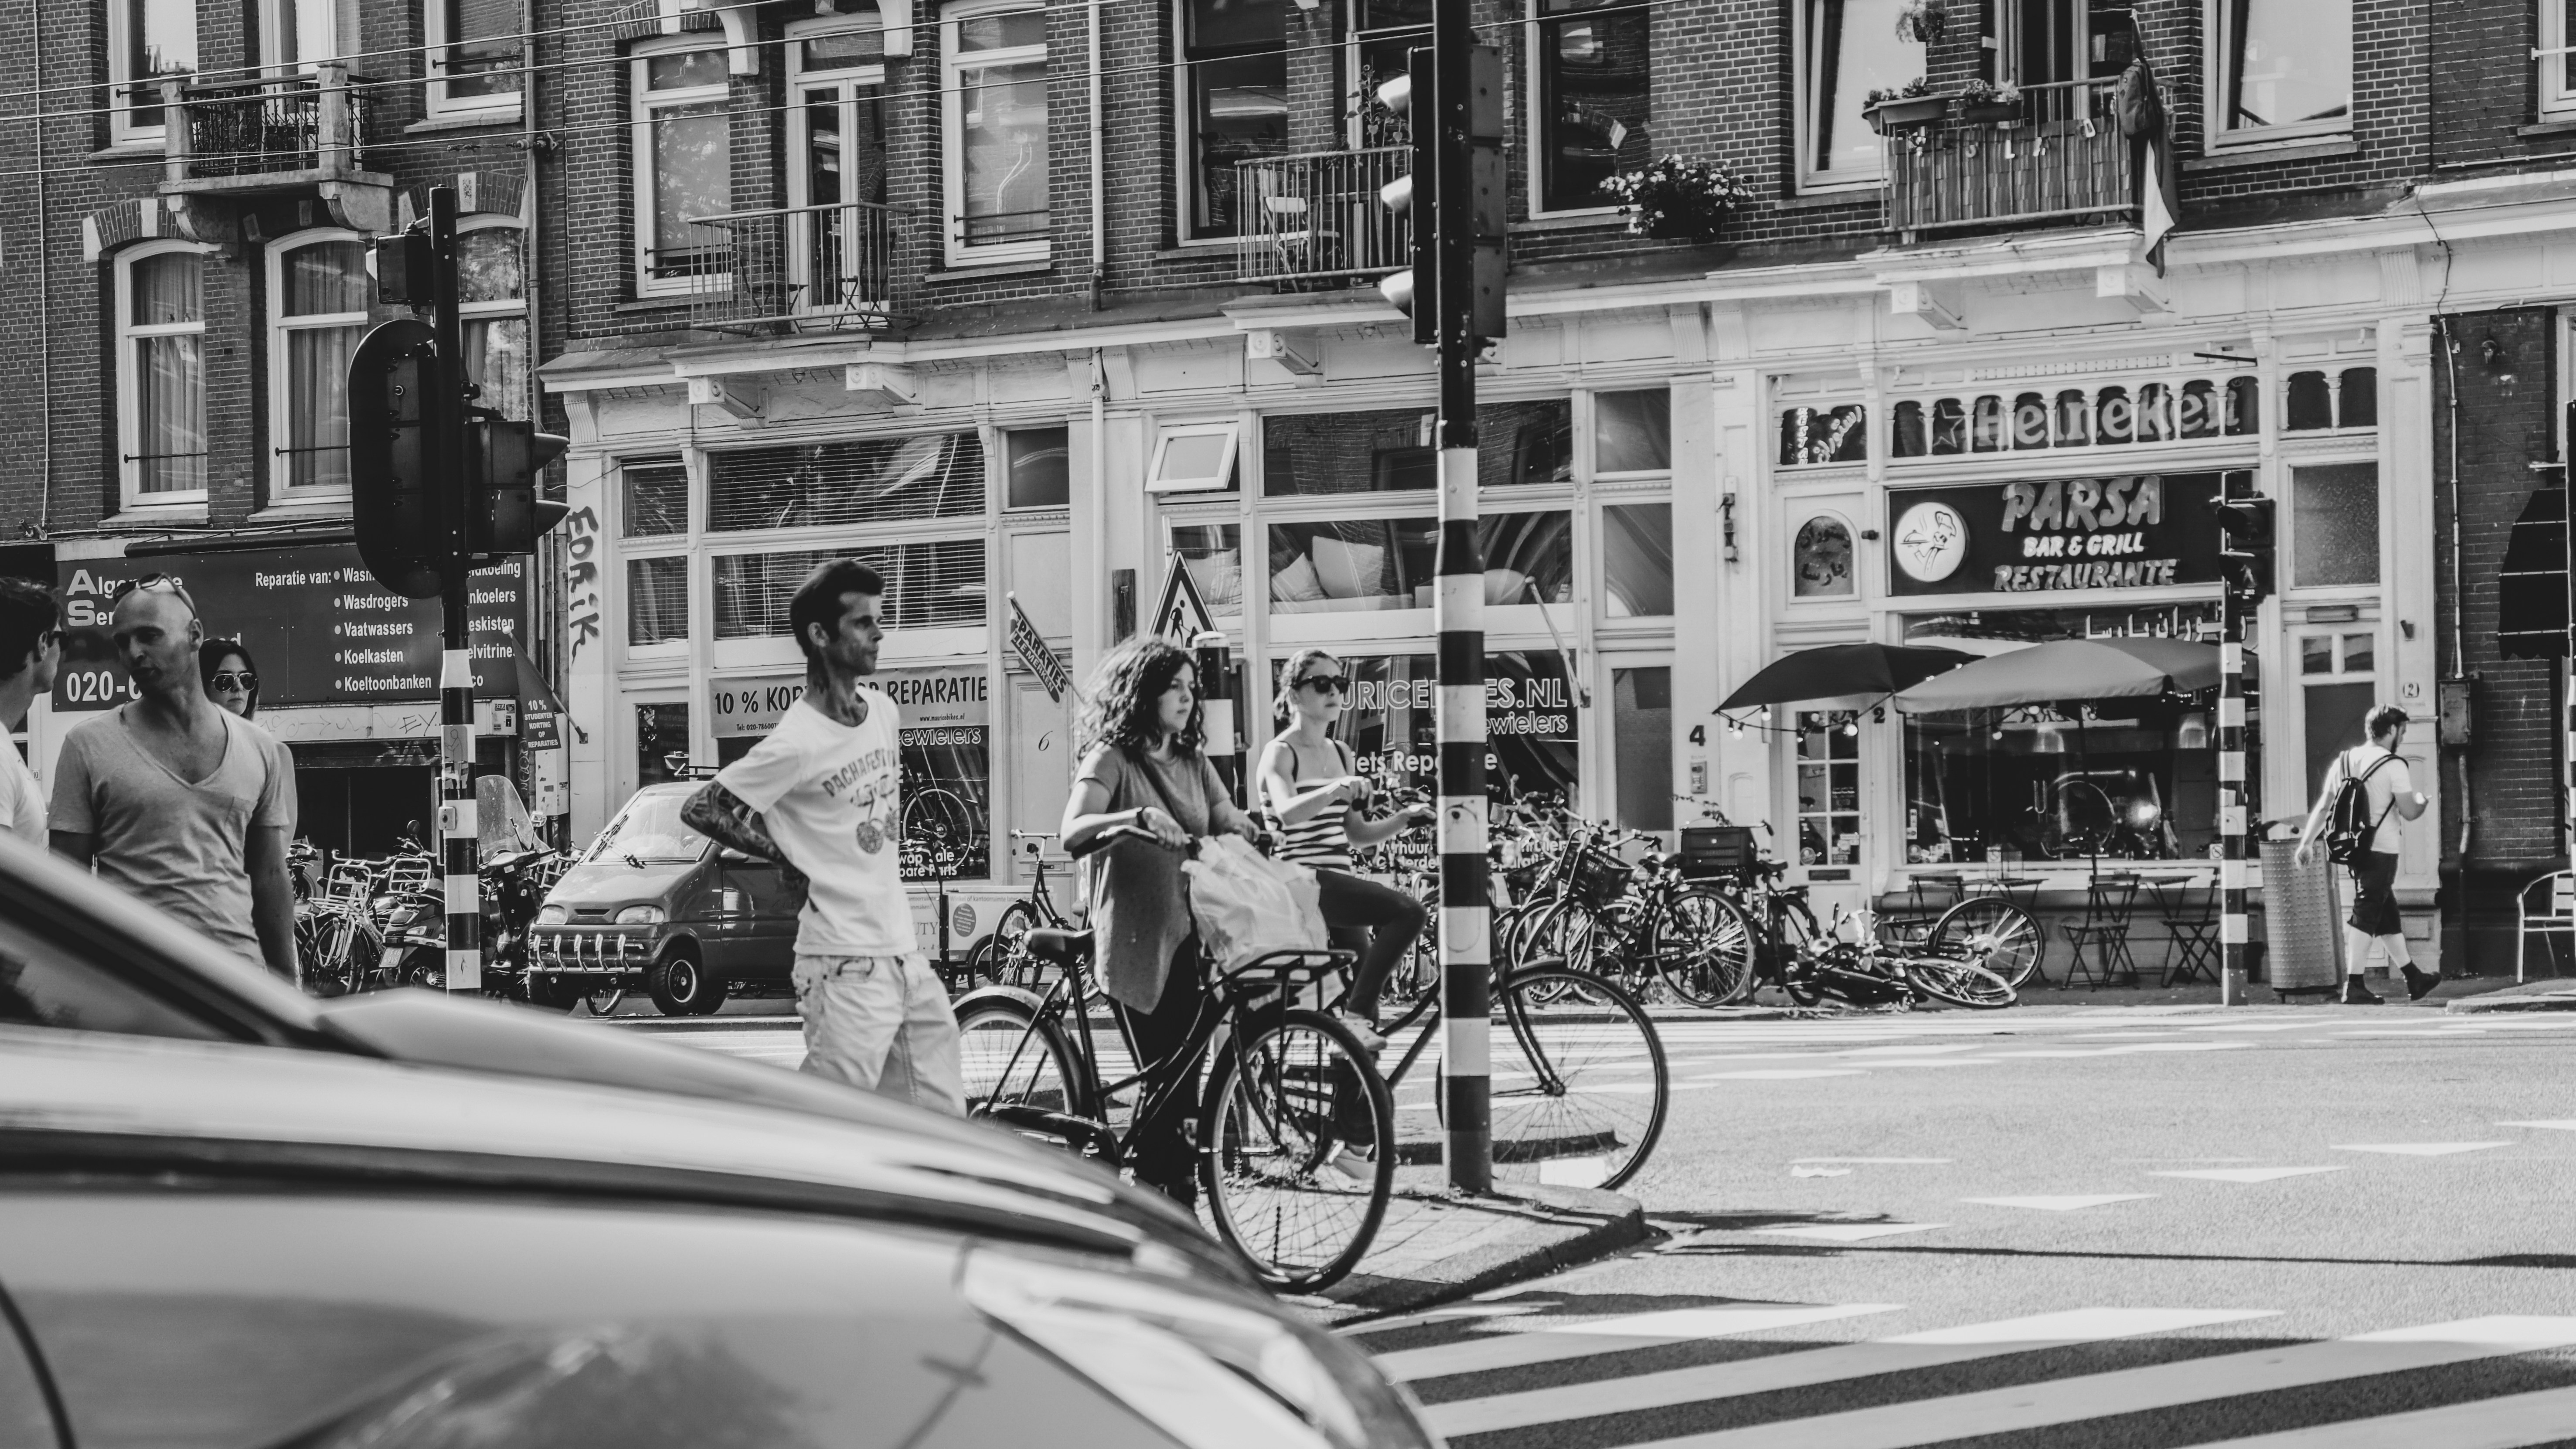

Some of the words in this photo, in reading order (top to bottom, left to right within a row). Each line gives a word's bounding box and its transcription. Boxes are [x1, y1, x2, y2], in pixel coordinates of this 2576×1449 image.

[2001, 475, 2160, 532] PARSA
[2023, 535, 2065, 557] BAR
[2068, 535, 2082, 556] &
[2086, 532, 2144, 556] GRILL
[255, 570, 306, 589] Reparatie
[309, 571, 331, 584] van:
[1994, 559, 2177, 592] RESTAURANTE
[343, 594, 408, 612] Wasdrogers
[469, 588, 516, 604] nkoelers
[344, 622, 413, 636] Vaatwassers
[469, 616, 514, 631] eskisten
[344, 648, 404, 664] Koelkasten
[1026, 650, 1054, 692] MERKEN
[344, 674, 432, 691] Koeltoonbanken
[715, 692, 734, 715] 10
[742, 690, 759, 714] %
[887, 677, 987, 705] REPARATIE
[528, 700, 538, 711] 10
[539, 700, 547, 710] %
[919, 713, 965, 722] www.mauricebikes.nl
[1874, 707, 1885, 724] 2
[528, 739, 558, 748] REPARATIES
[899, 728, 981, 746] ewielers
[1038, 731, 1053, 752] 6
[1689, 725, 1706, 746] 4
[1351, 751, 1386, 772] iets
[899, 854, 923, 866] wap
